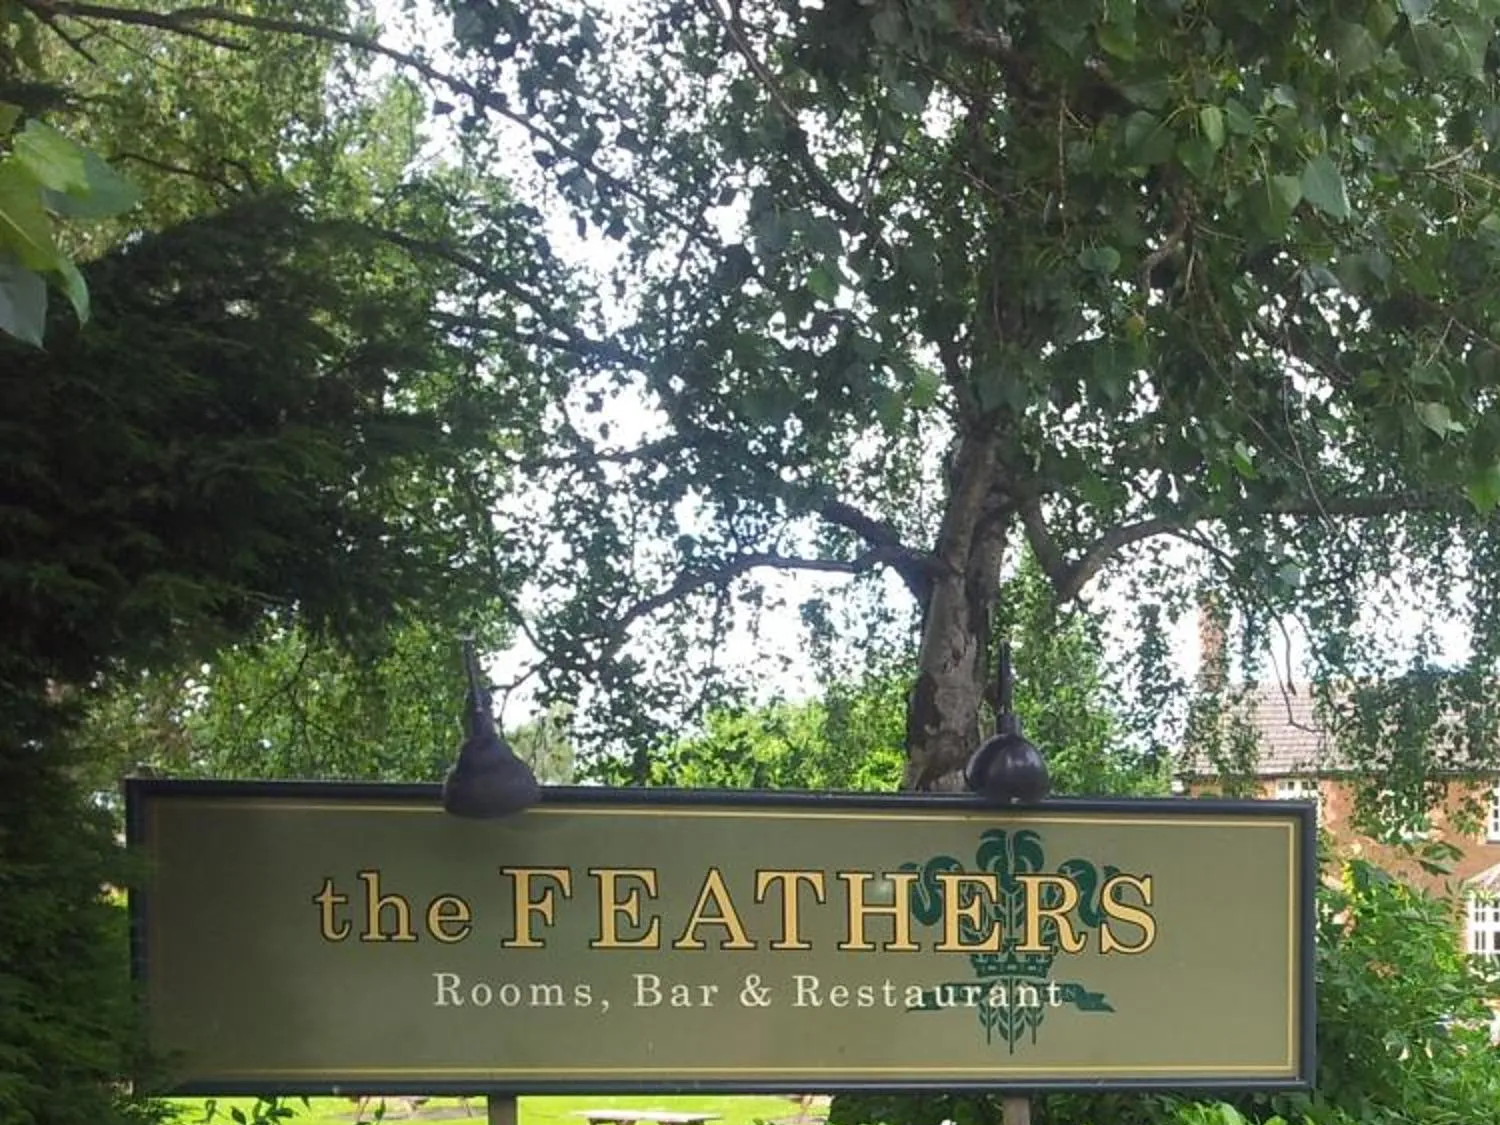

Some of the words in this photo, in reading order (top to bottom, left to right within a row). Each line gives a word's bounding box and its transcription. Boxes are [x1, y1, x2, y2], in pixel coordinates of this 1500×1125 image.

[313, 869, 473, 943] the
[500, 866, 1158, 954] FEATHERS
[432, 972, 612, 1012] Rooms,
[632, 973, 720, 1008] Bar
[738, 975, 772, 1008] &
[793, 975, 1064, 1008] Restaurant
